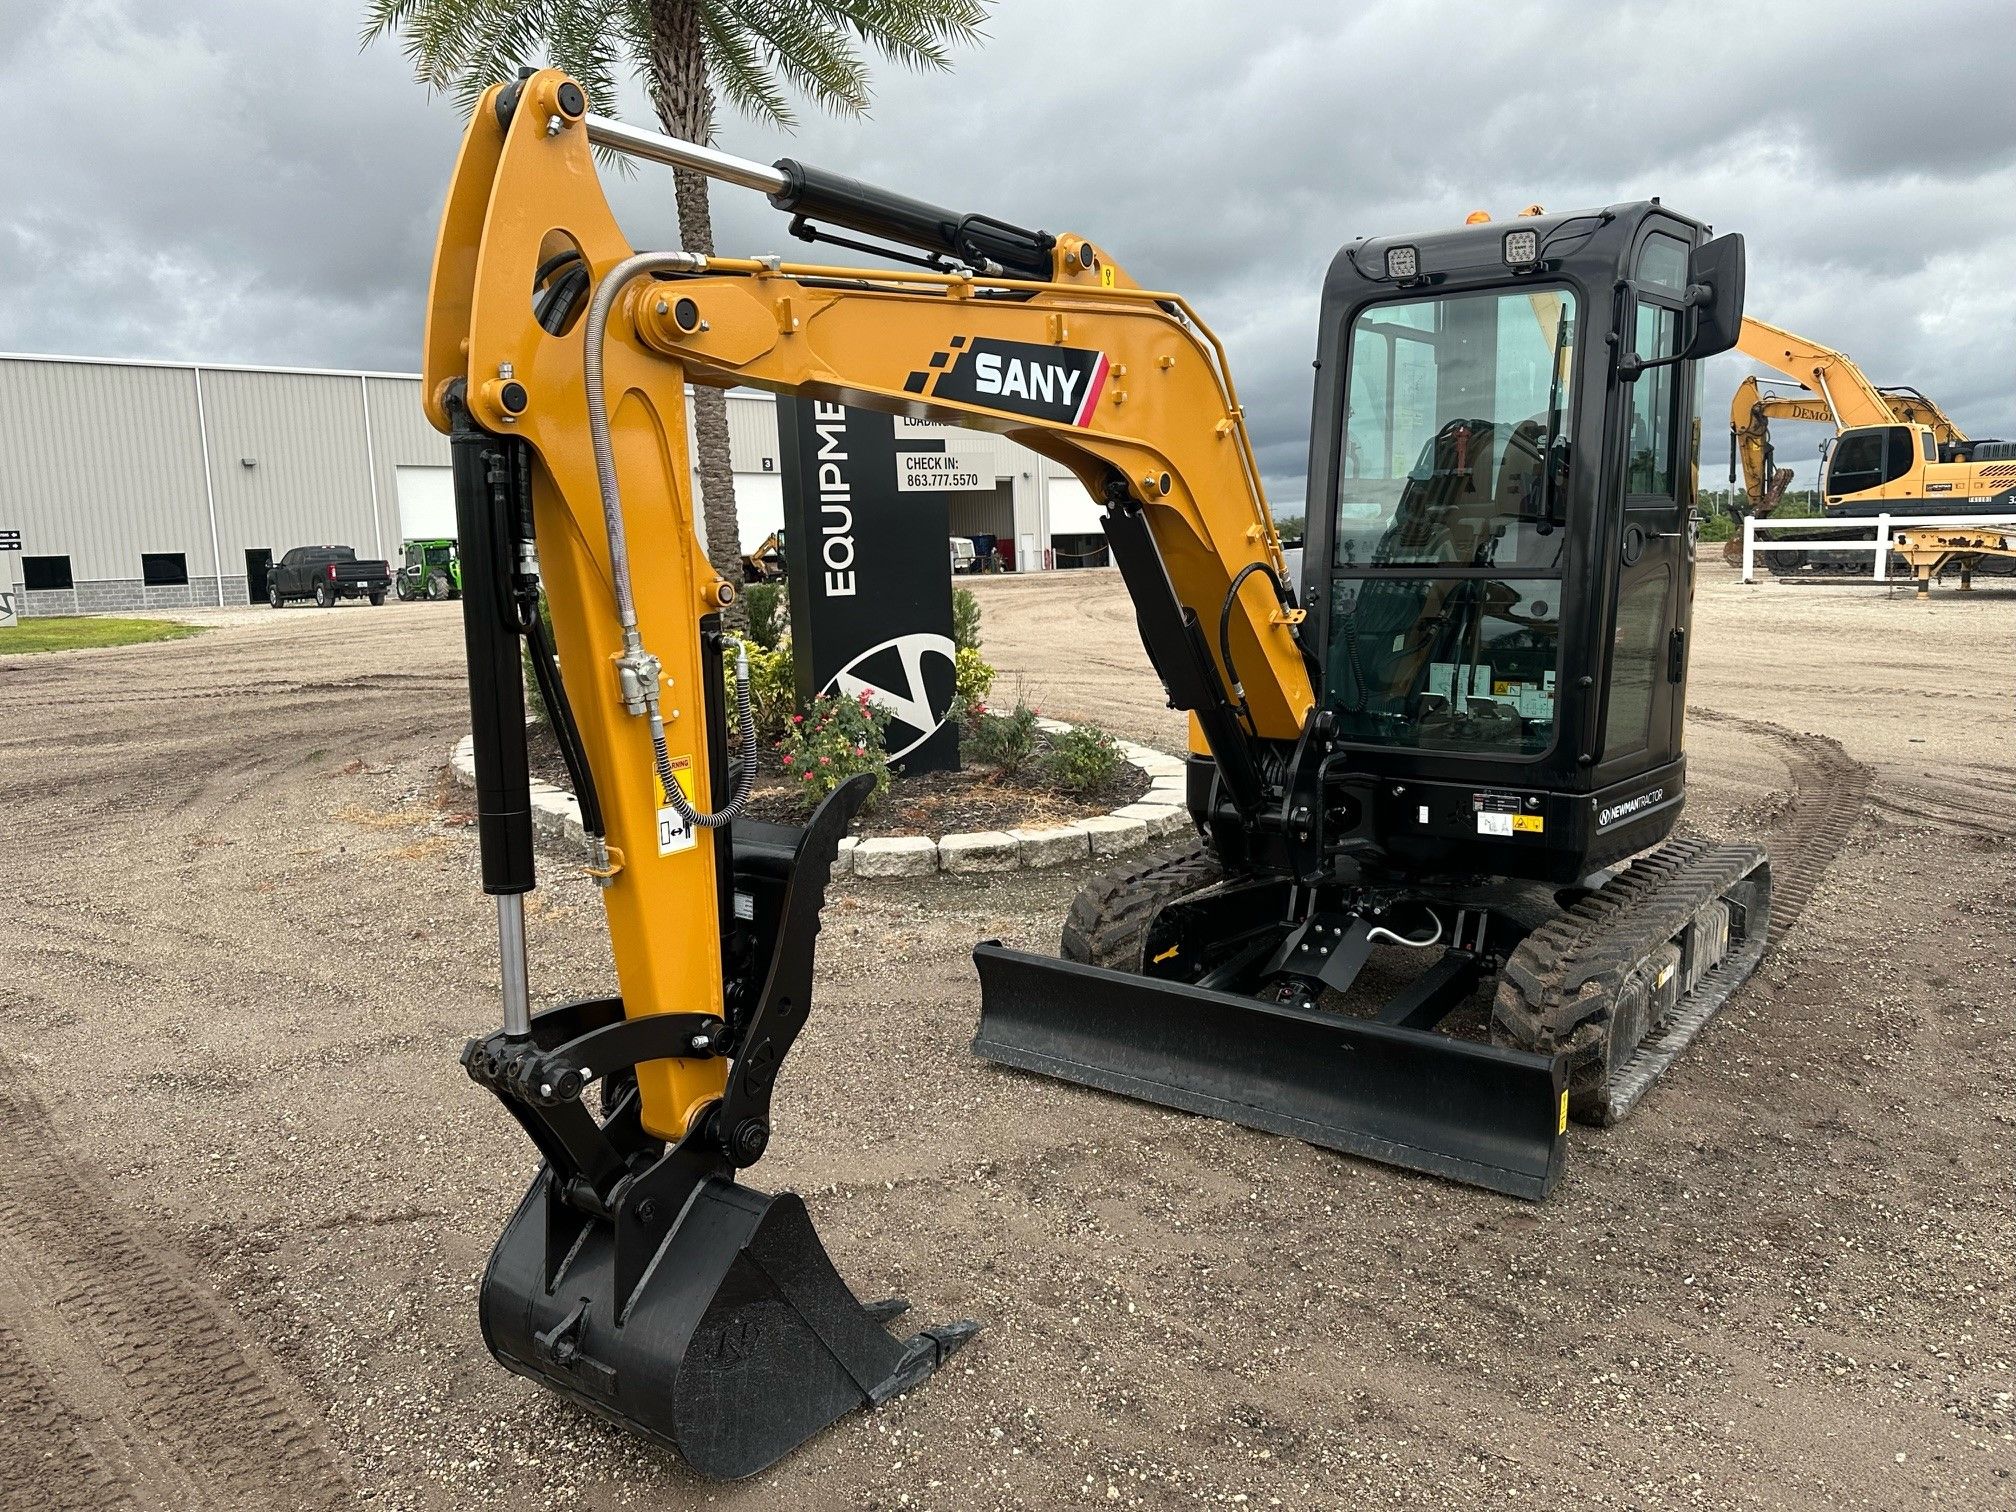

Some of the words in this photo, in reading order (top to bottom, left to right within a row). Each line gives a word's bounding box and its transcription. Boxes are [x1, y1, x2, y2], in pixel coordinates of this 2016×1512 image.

[975, 352, 1080, 406] SANY
[764, 460, 771, 468] 3
[906, 457, 942, 470] CHECK
[944, 457, 959, 470] IN:
[907, 473, 978, 487] 863.777.5570
